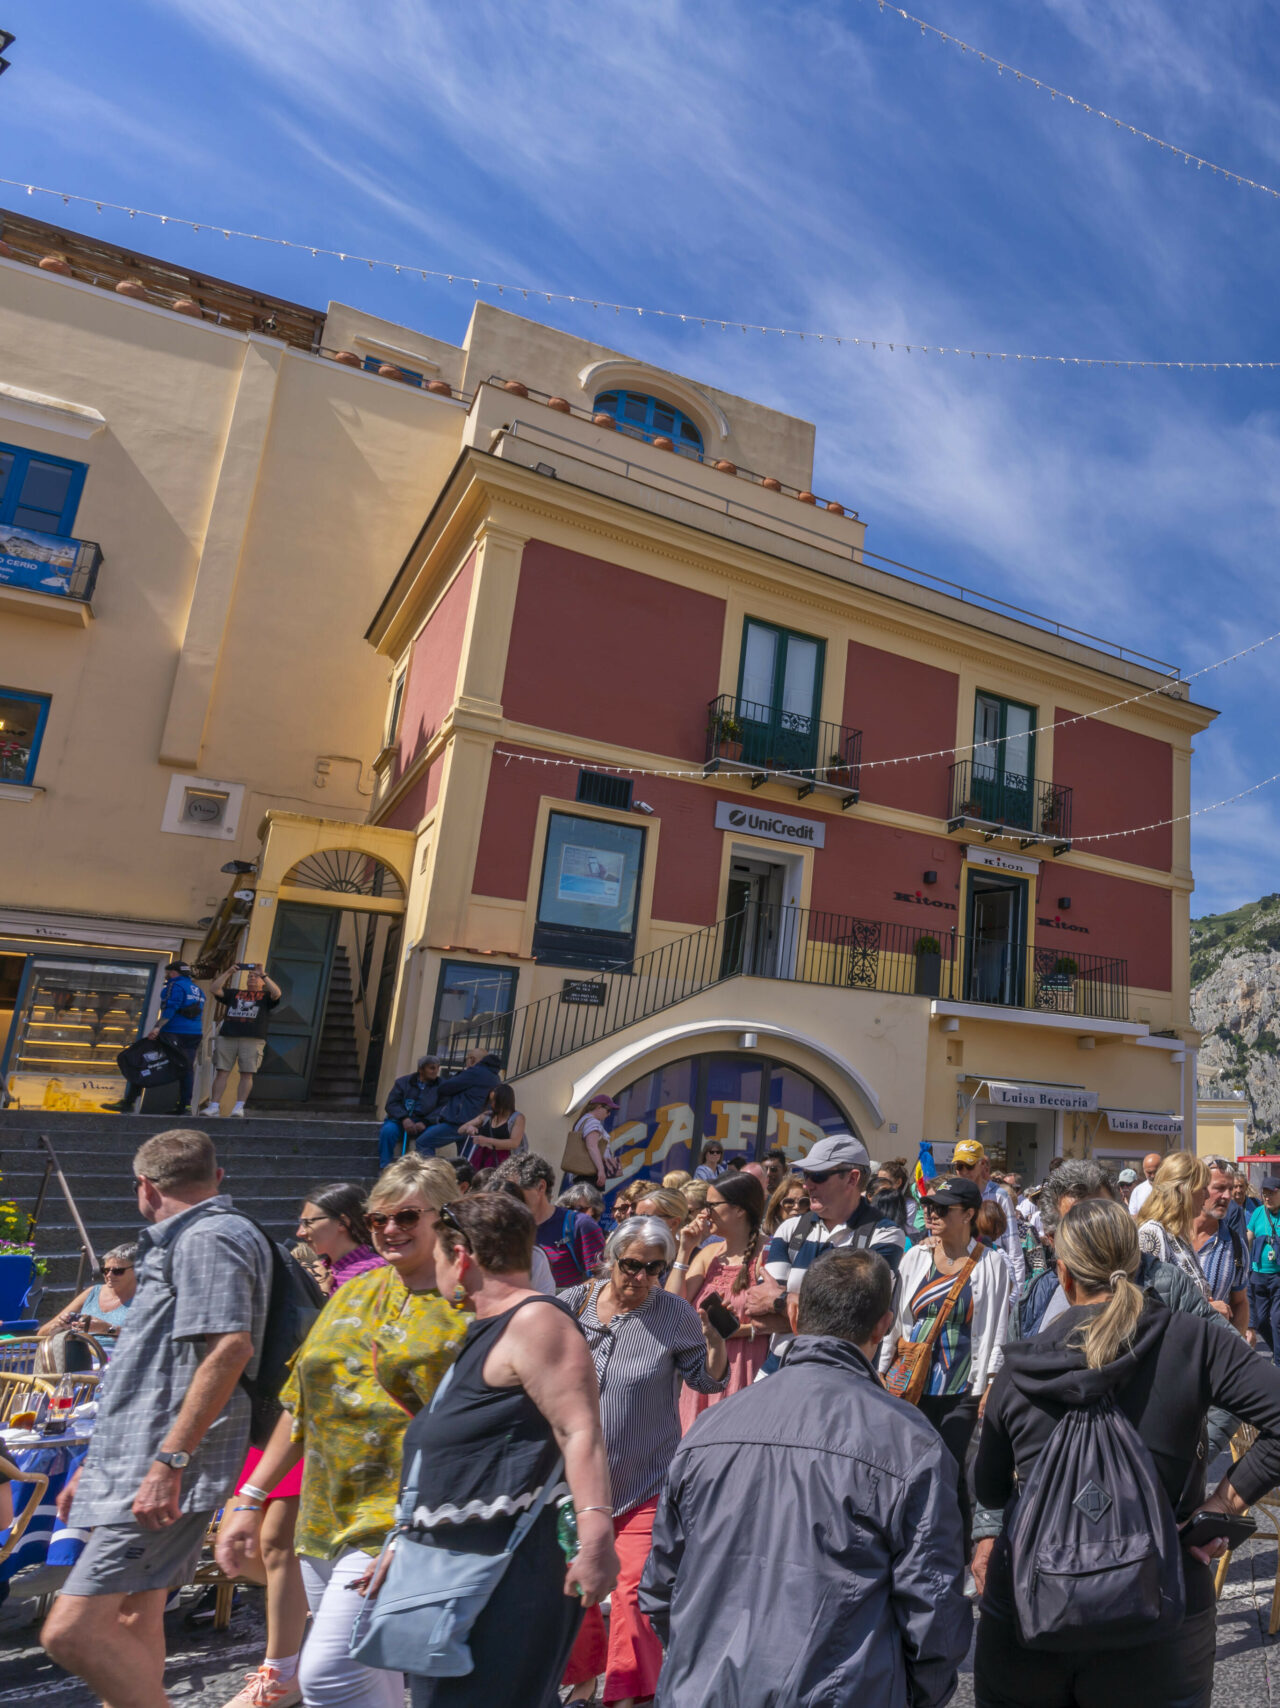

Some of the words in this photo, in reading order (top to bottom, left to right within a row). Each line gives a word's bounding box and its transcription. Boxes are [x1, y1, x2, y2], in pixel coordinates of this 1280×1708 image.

[6, 558, 38, 571] CERIO
[748, 814, 815, 841] UniCredit
[983, 857, 1024, 872] Kiton
[893, 890, 957, 911] Kiton
[1037, 915, 1090, 935] Kiton
[81, 1080, 116, 1090] Nino
[1002, 1091, 1035, 1104] Luisa
[1039, 1093, 1088, 1108] Beccaria
[1111, 1118, 1139, 1130] Luisa
[1141, 1119, 1182, 1132] Beccaria
[605, 1100, 829, 1189] CAPR
